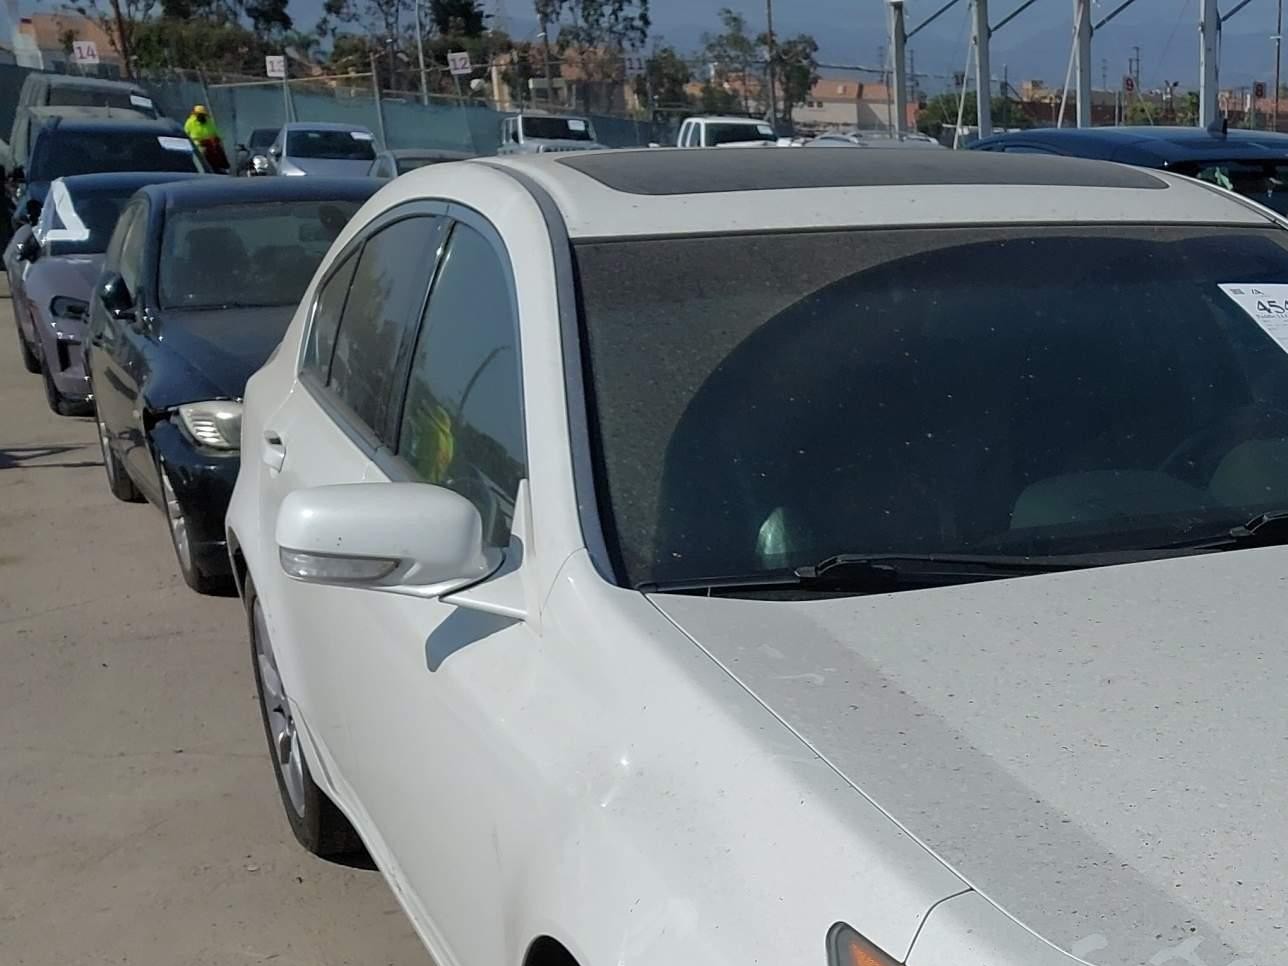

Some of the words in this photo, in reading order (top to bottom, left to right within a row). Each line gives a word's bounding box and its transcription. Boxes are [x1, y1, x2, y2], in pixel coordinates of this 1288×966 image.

[75, 45, 97, 60] 14
[450, 57, 469, 71] 12
[626, 57, 644, 71] 11
